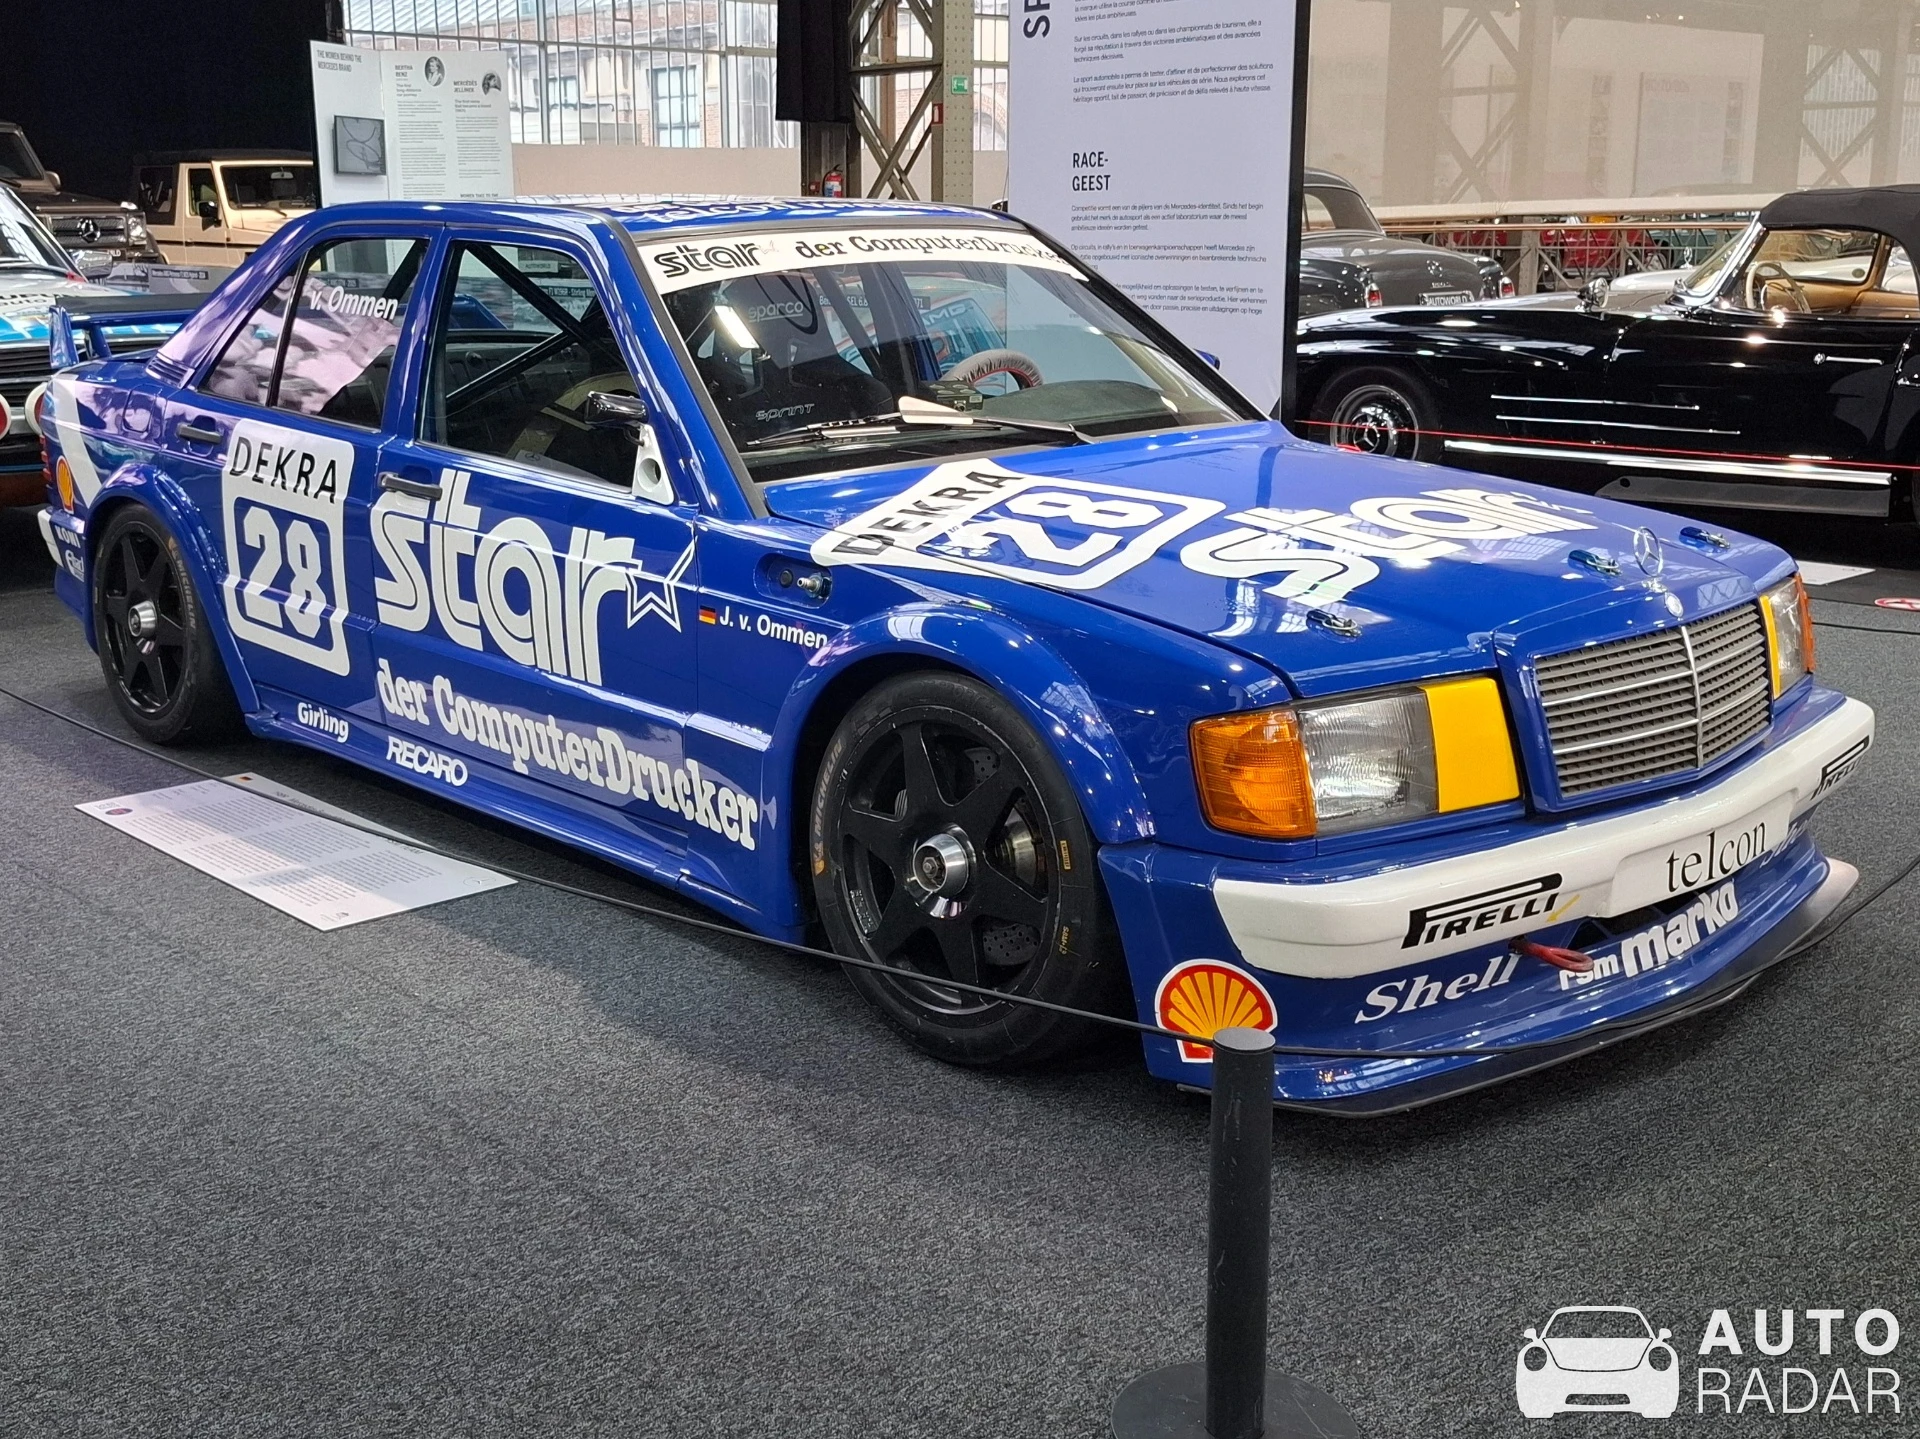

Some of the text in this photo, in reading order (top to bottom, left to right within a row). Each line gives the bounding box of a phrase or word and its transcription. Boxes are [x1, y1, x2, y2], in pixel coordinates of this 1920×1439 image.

[1072, 151, 1108, 168] RACE-
[1072, 174, 1111, 191] GEEST
[653, 242, 763, 278] star
[795, 240, 848, 258] der
[310, 286, 398, 320] v. Ommen
[750, 300, 803, 322] sparco
[1428, 296, 1467, 306] AUTOWORLD
[229, 436, 337, 504] DEKRA
[55, 525, 81, 548] KONI
[832, 470, 1026, 556] DEKRA
[962, 492, 1163, 567] 28
[1179, 488, 1599, 607] star
[176, 560, 196, 629] MICHELIN
[243, 505, 326, 638] 28
[370, 469, 635, 686] star
[720, 606, 828, 649] J. v. Ommen
[297, 702, 349, 744] Girling
[377, 658, 431, 726] der
[432, 676, 758, 852] ComputerDrucker
[386, 736, 468, 787] RECARO
[814, 738, 842, 837] MICHELIN
[1666, 821, 1767, 893] telcon
[1401, 872, 1563, 950] PIRELLI
[1621, 878, 1740, 978] marko
[1354, 954, 1522, 1024] Shell
